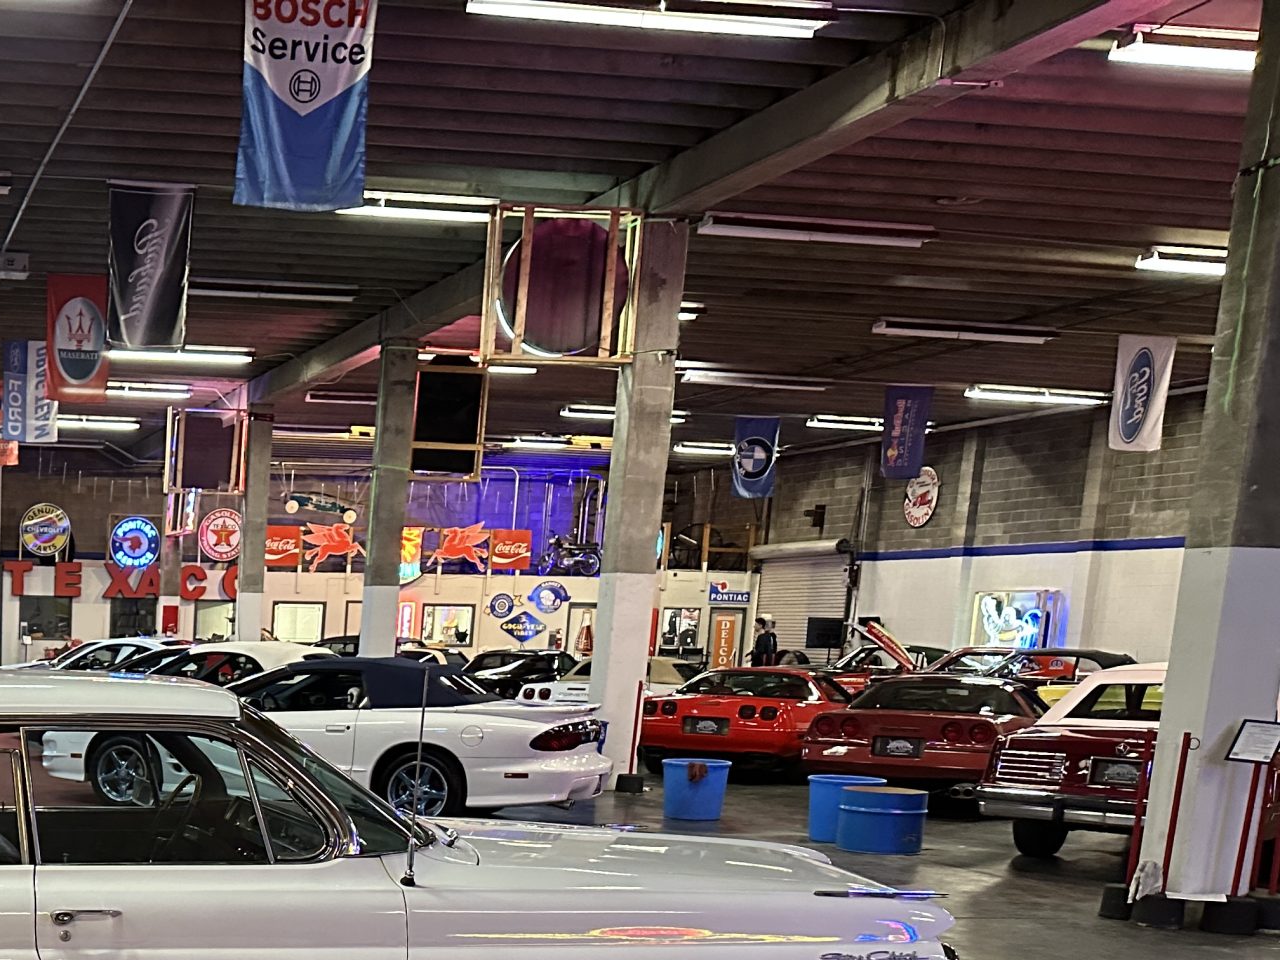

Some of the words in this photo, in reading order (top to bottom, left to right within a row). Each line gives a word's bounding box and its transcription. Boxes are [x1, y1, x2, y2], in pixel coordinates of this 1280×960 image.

[253, 0, 370, 28] BOSCH
[250, 26, 366, 66] Service
[59, 351, 99, 360] MASERATI
[27, 506, 65, 522] GENUINE
[115, 519, 157, 538] PONTIAC
[31, 542, 57, 552] PARTS
[494, 541, 528, 555] Coca-Cola
[115, 550, 154, 566] SERVICE
[710, 593, 749, 602] PONTIAC
[718, 620, 731, 665] DELCO
